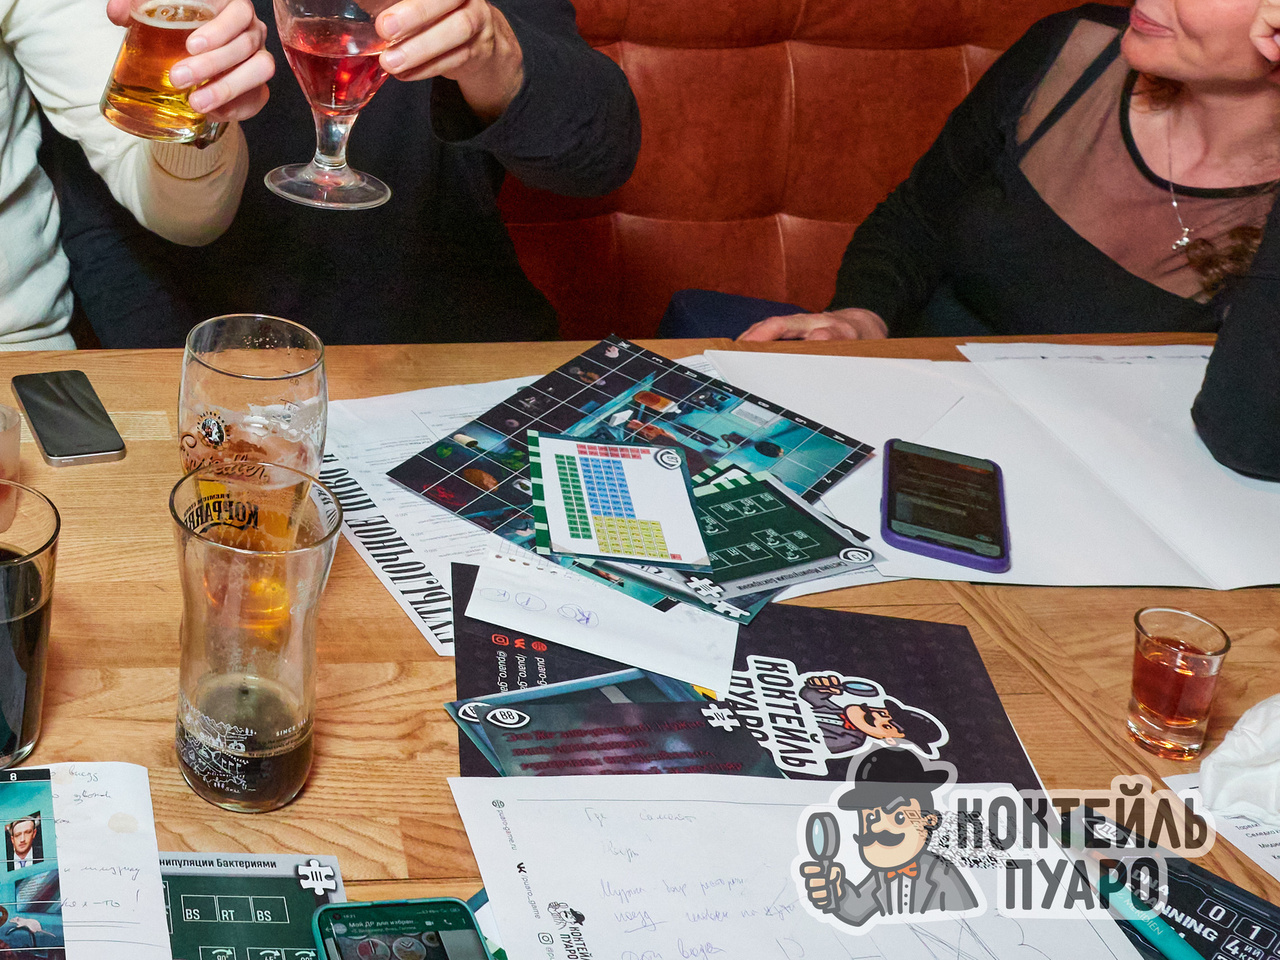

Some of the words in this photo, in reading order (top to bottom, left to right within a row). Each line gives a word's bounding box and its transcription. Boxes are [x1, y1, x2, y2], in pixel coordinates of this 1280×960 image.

[535, 657, 548, 687] puaro-g
[725, 675, 769, 742] ПУАРО
[754, 660, 821, 768] КОКТЕЙЛЬ
[276, 726, 296, 737] SINCE
[9, 772, 17, 781] 8
[159, 858, 214, 869] нипуляции
[216, 858, 277, 869] Бактериями
[1131, 869, 1169, 896] DNA
[521, 874, 541, 920] /puaro_game
[185, 909, 200, 920] BS
[221, 909, 235, 920] RT
[256, 910, 271, 921] BS
[1125, 882, 1219, 942] SCANNING
[1208, 905, 1226, 921] 0
[569, 926, 594, 960] КОКТЕЙ
[1248, 925, 1262, 940] 1
[1225, 939, 1241, 955] 4
